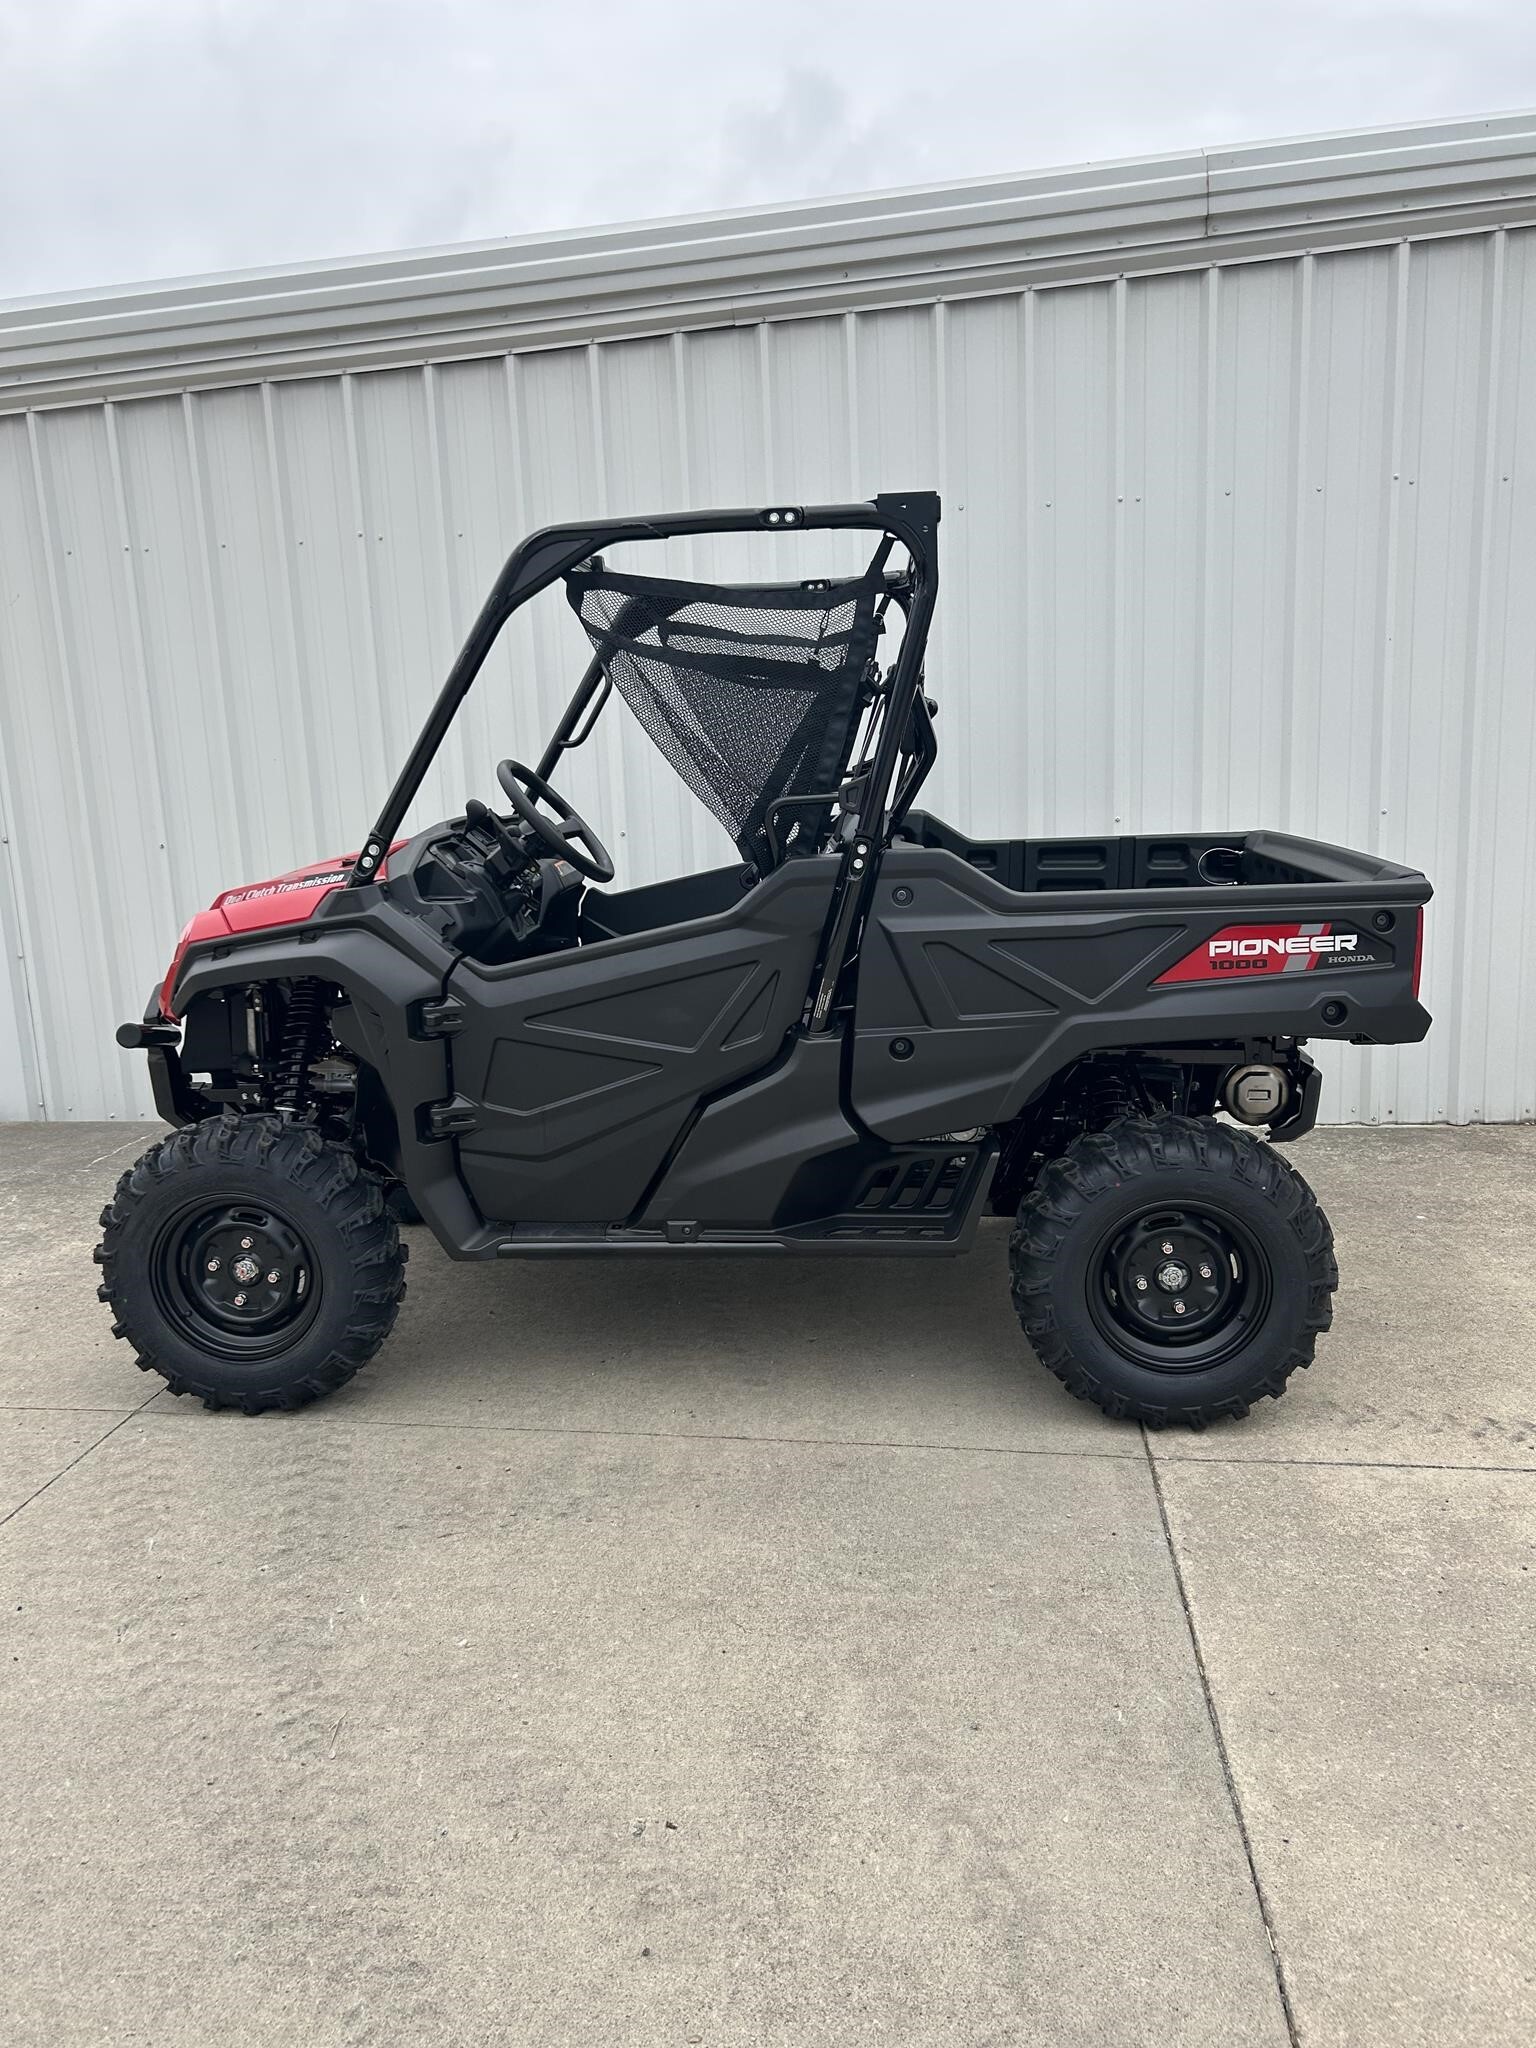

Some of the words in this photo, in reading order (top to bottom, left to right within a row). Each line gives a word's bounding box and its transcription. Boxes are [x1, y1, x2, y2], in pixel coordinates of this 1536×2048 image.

[247, 886, 276, 900] Clutch
[276, 874, 345, 893] Transmission
[1208, 934, 1358, 957] PIONEER
[1209, 959, 1268, 970] 1000
[1327, 954, 1376, 963] HONDA
